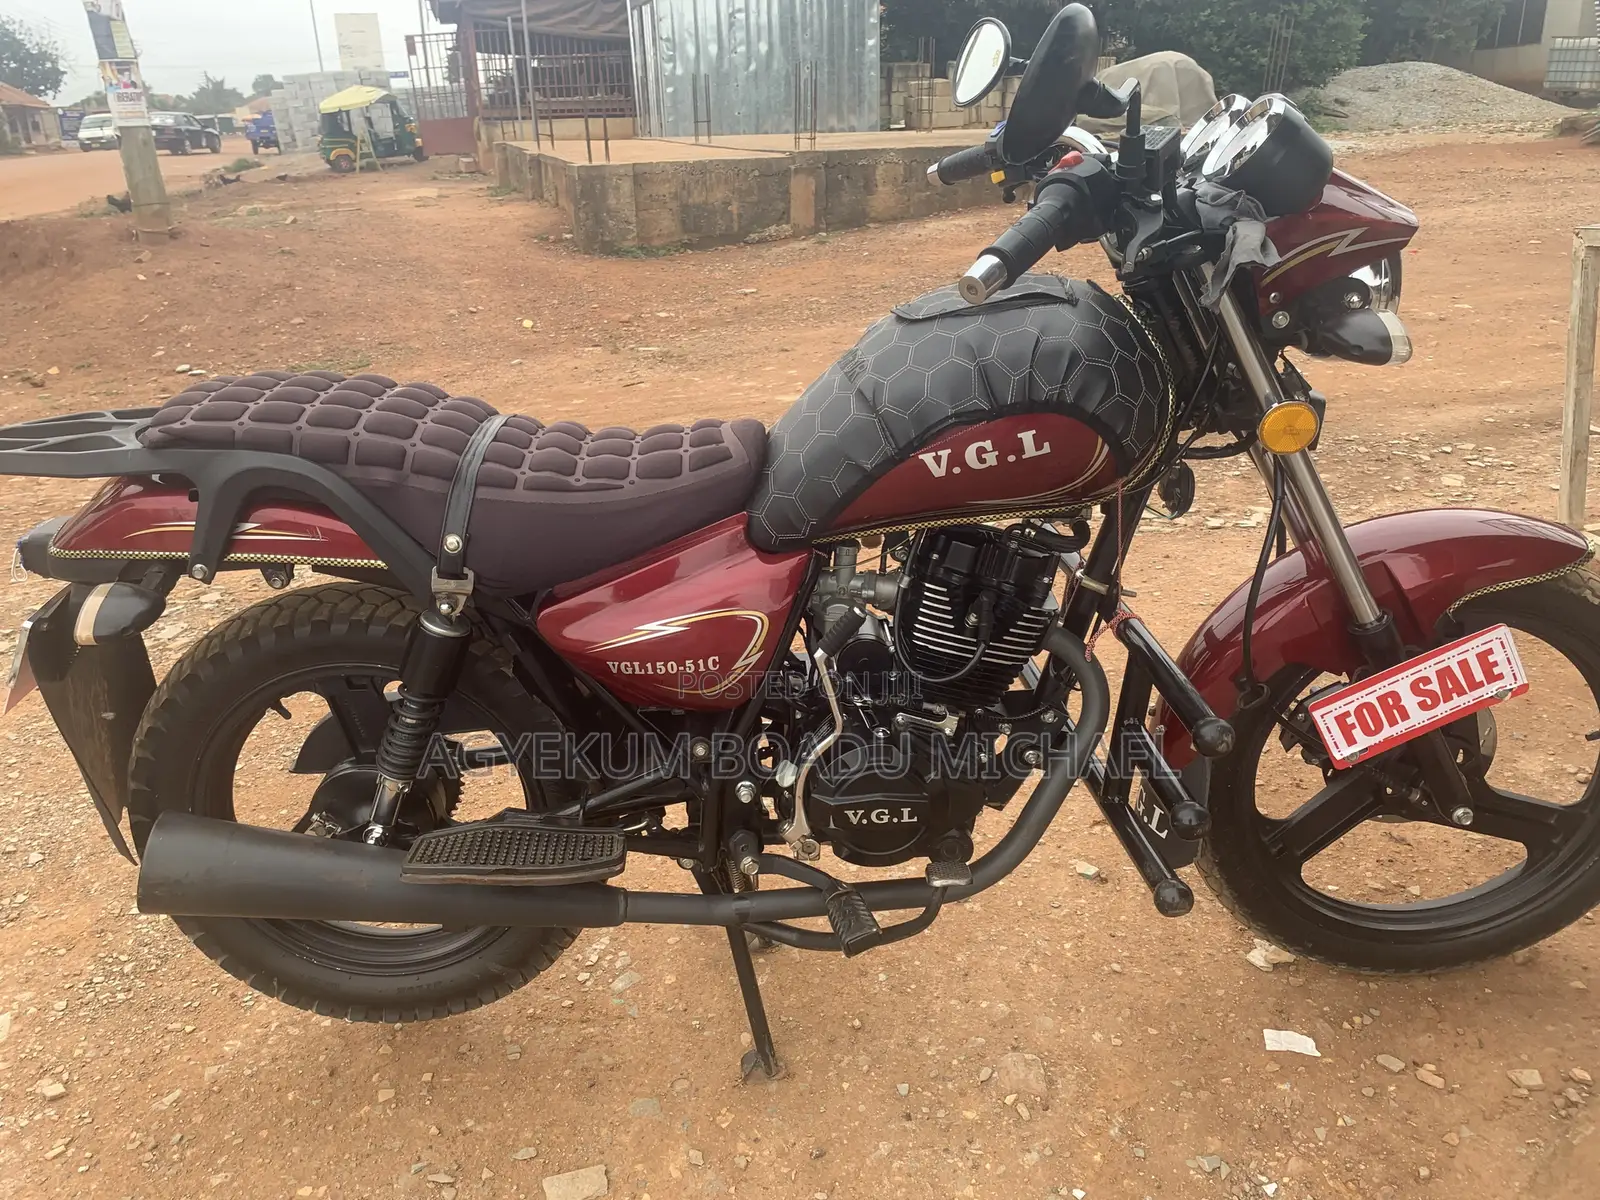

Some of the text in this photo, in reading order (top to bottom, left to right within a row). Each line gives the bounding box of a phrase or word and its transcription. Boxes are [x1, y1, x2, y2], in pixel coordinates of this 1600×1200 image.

[918, 429, 1051, 478] V.G.L
[607, 656, 720, 675] VGL150-51C
[1334, 647, 1505, 748] FOR SALE
[844, 808, 918, 825] V.G.L
